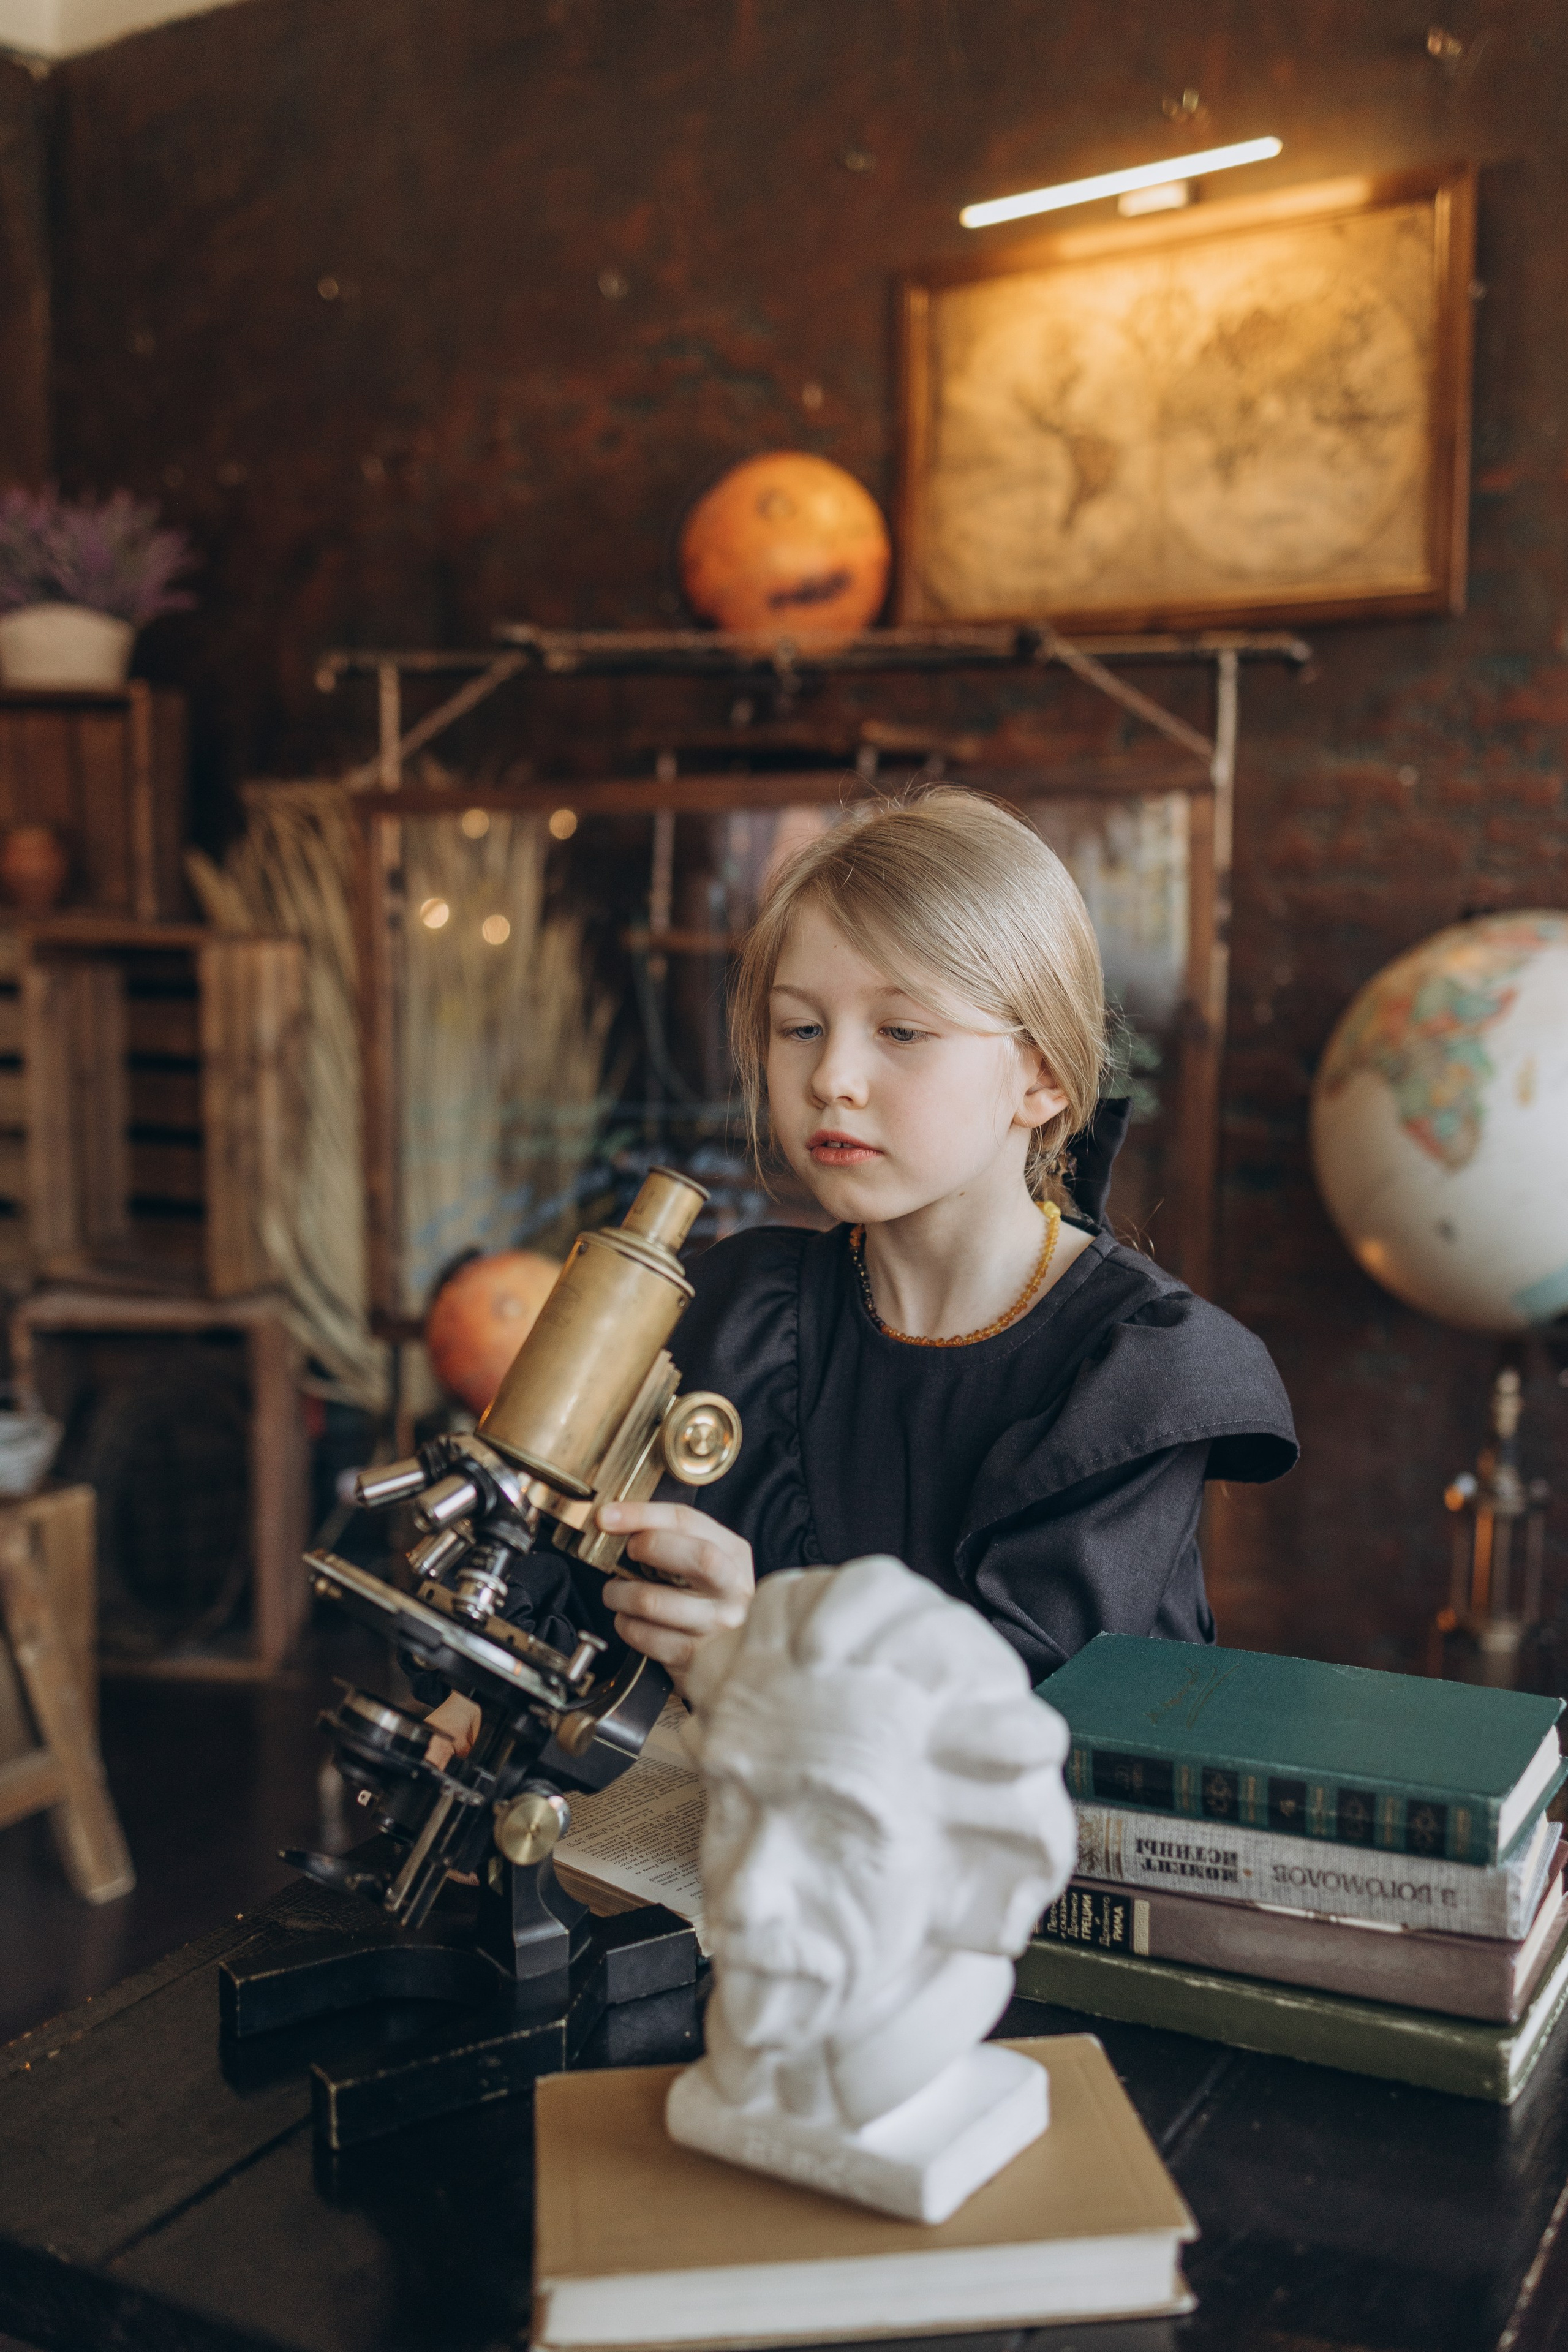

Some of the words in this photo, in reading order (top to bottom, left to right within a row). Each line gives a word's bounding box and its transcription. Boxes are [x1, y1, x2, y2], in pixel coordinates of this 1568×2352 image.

[1135, 1838, 1238, 1866] ИСТИНЫ
[1139, 1857, 1238, 1883] МОМЕНТ
[1082, 1894, 1093, 1940] ГРЕЦИИ
[1099, 1896, 1111, 1947] Древнего
[1112, 1905, 1125, 1941] РИМА
